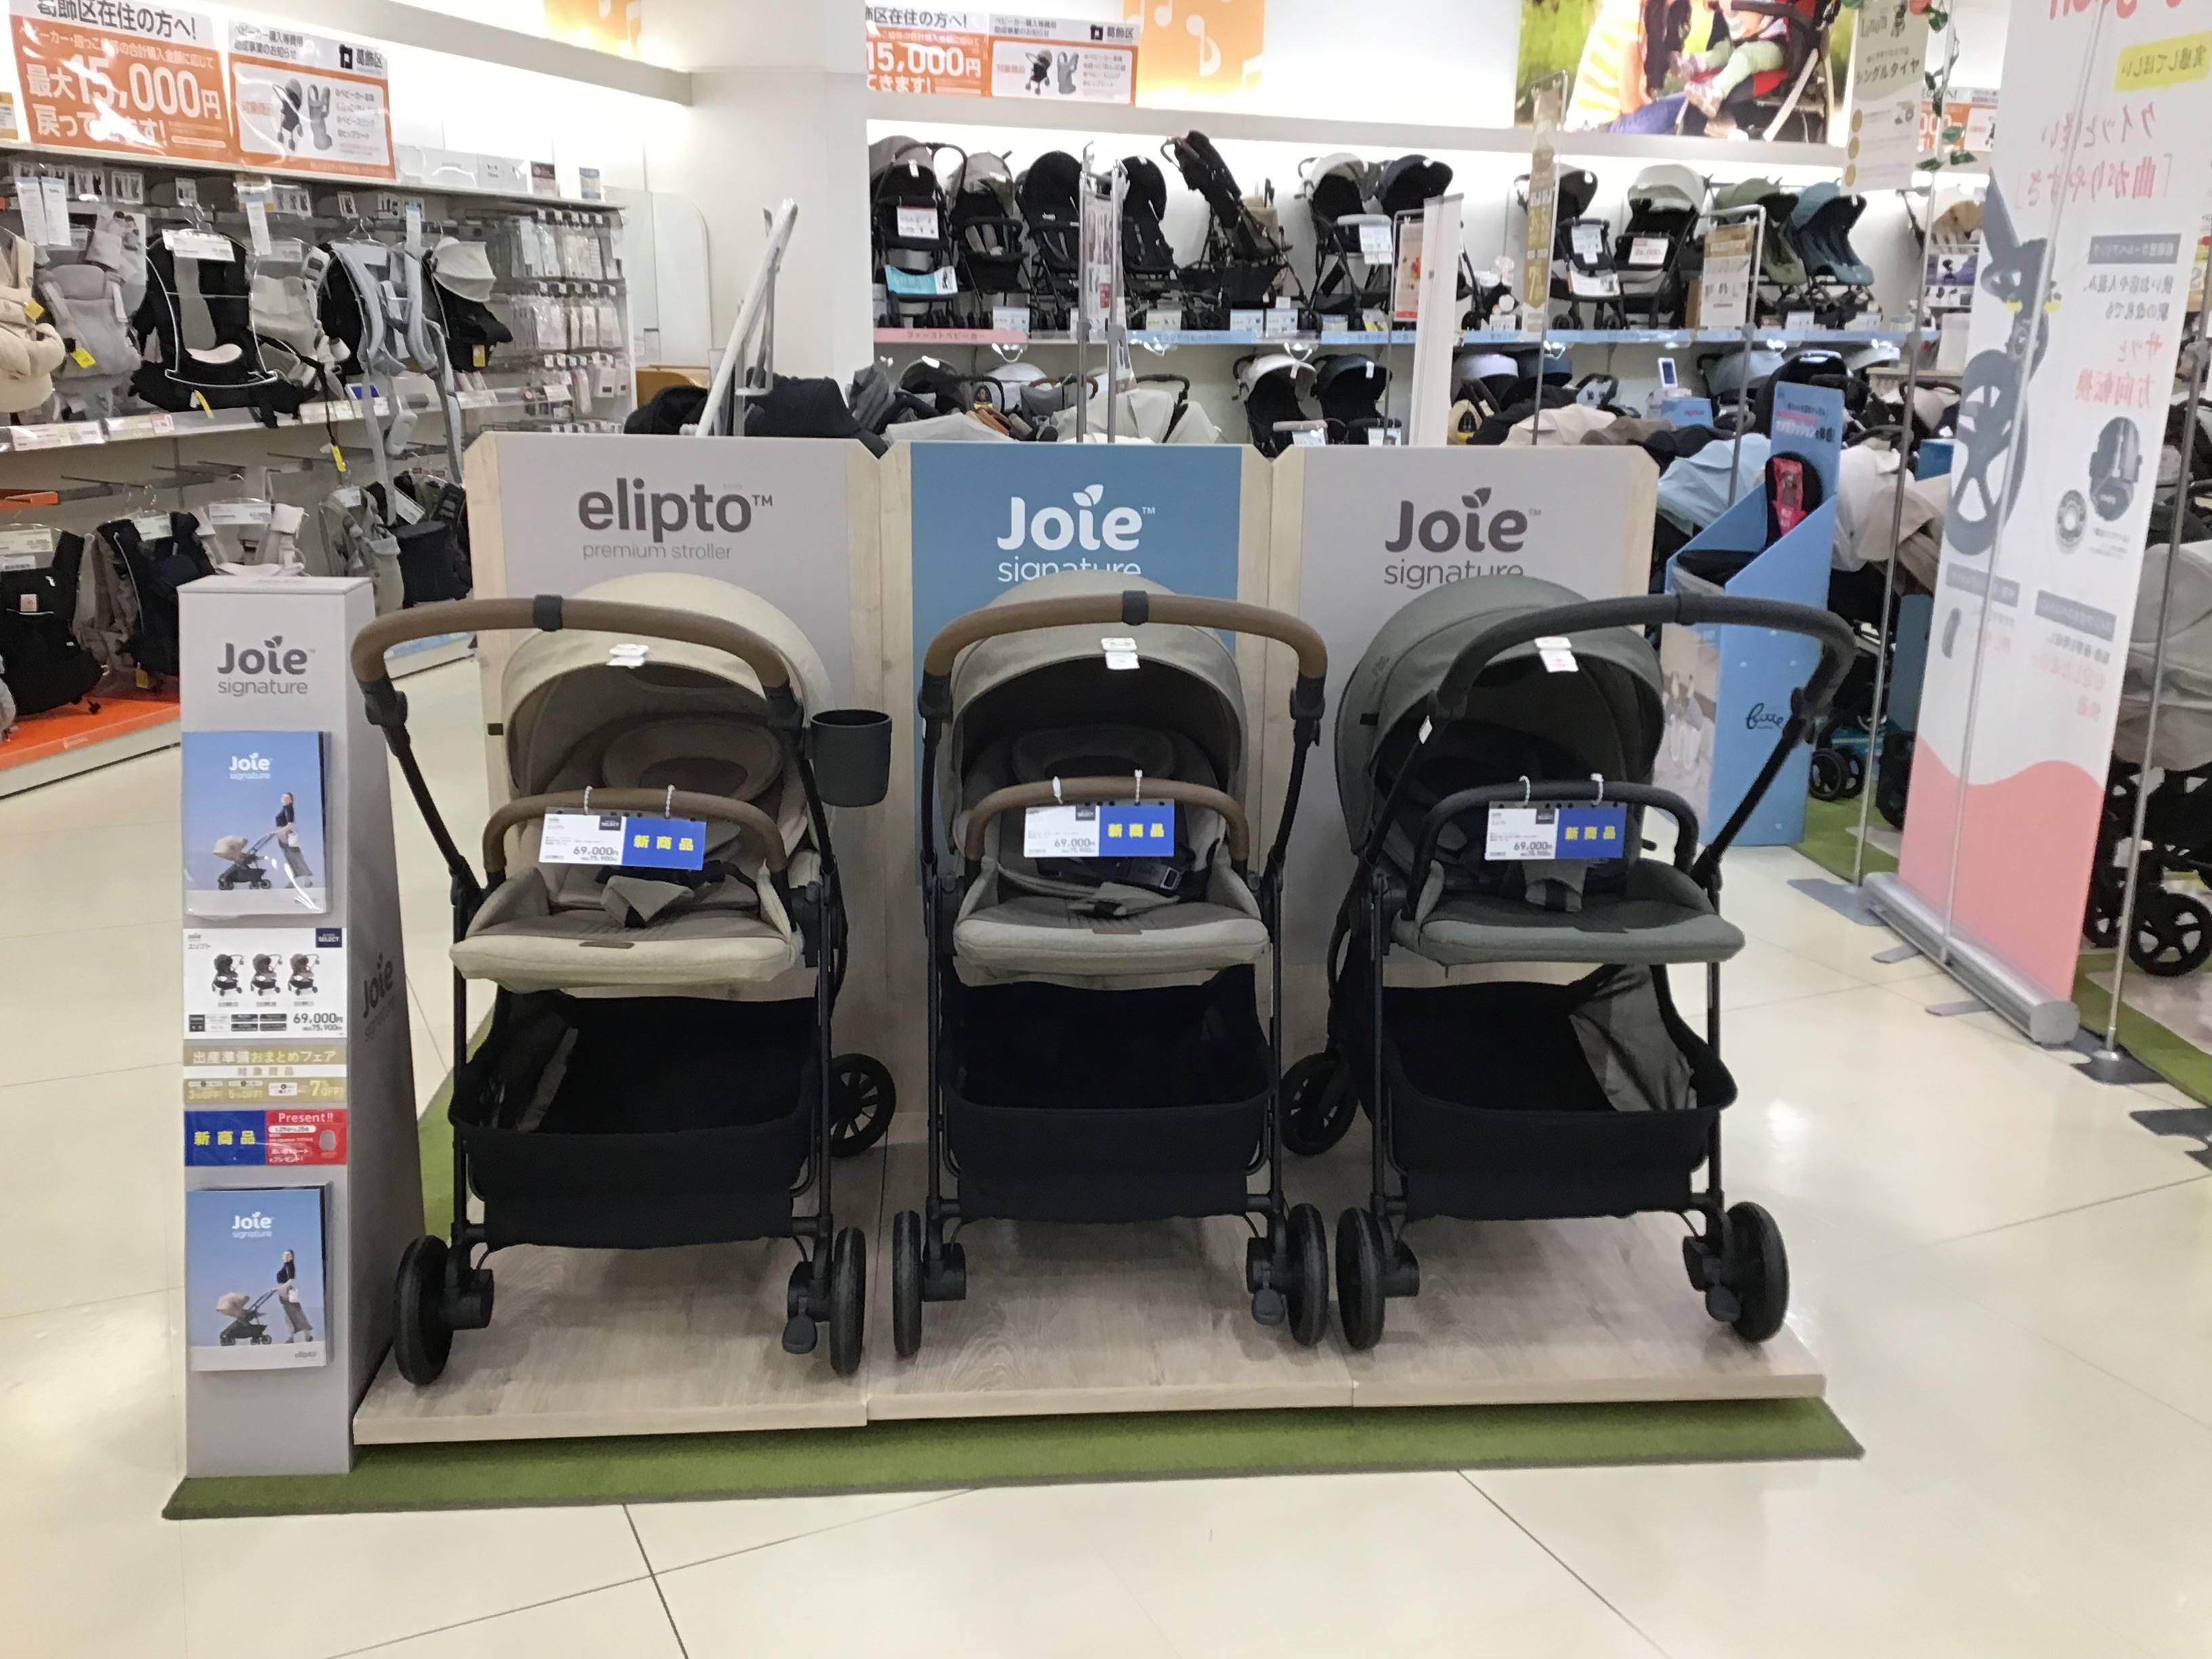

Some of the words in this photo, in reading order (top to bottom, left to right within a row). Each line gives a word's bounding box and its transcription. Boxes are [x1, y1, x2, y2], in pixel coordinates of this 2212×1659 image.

[578, 477, 752, 543] elipto
[997, 484, 1143, 551] Joie
[1385, 487, 1528, 553] Joie
[583, 544, 666, 560] premium
[672, 543, 733, 560] stroller
[216, 635, 308, 675] Joie
[217, 677, 308, 697] signature
[229, 753, 270, 771] Joie
[230, 771, 270, 780] signature
[634, 834, 694, 851] 新商品
[363, 951, 393, 1019] Joie
[194, 1130, 255, 1145] 新商品
[232, 1212, 272, 1230] Joie
[232, 1230, 272, 1239] signature
